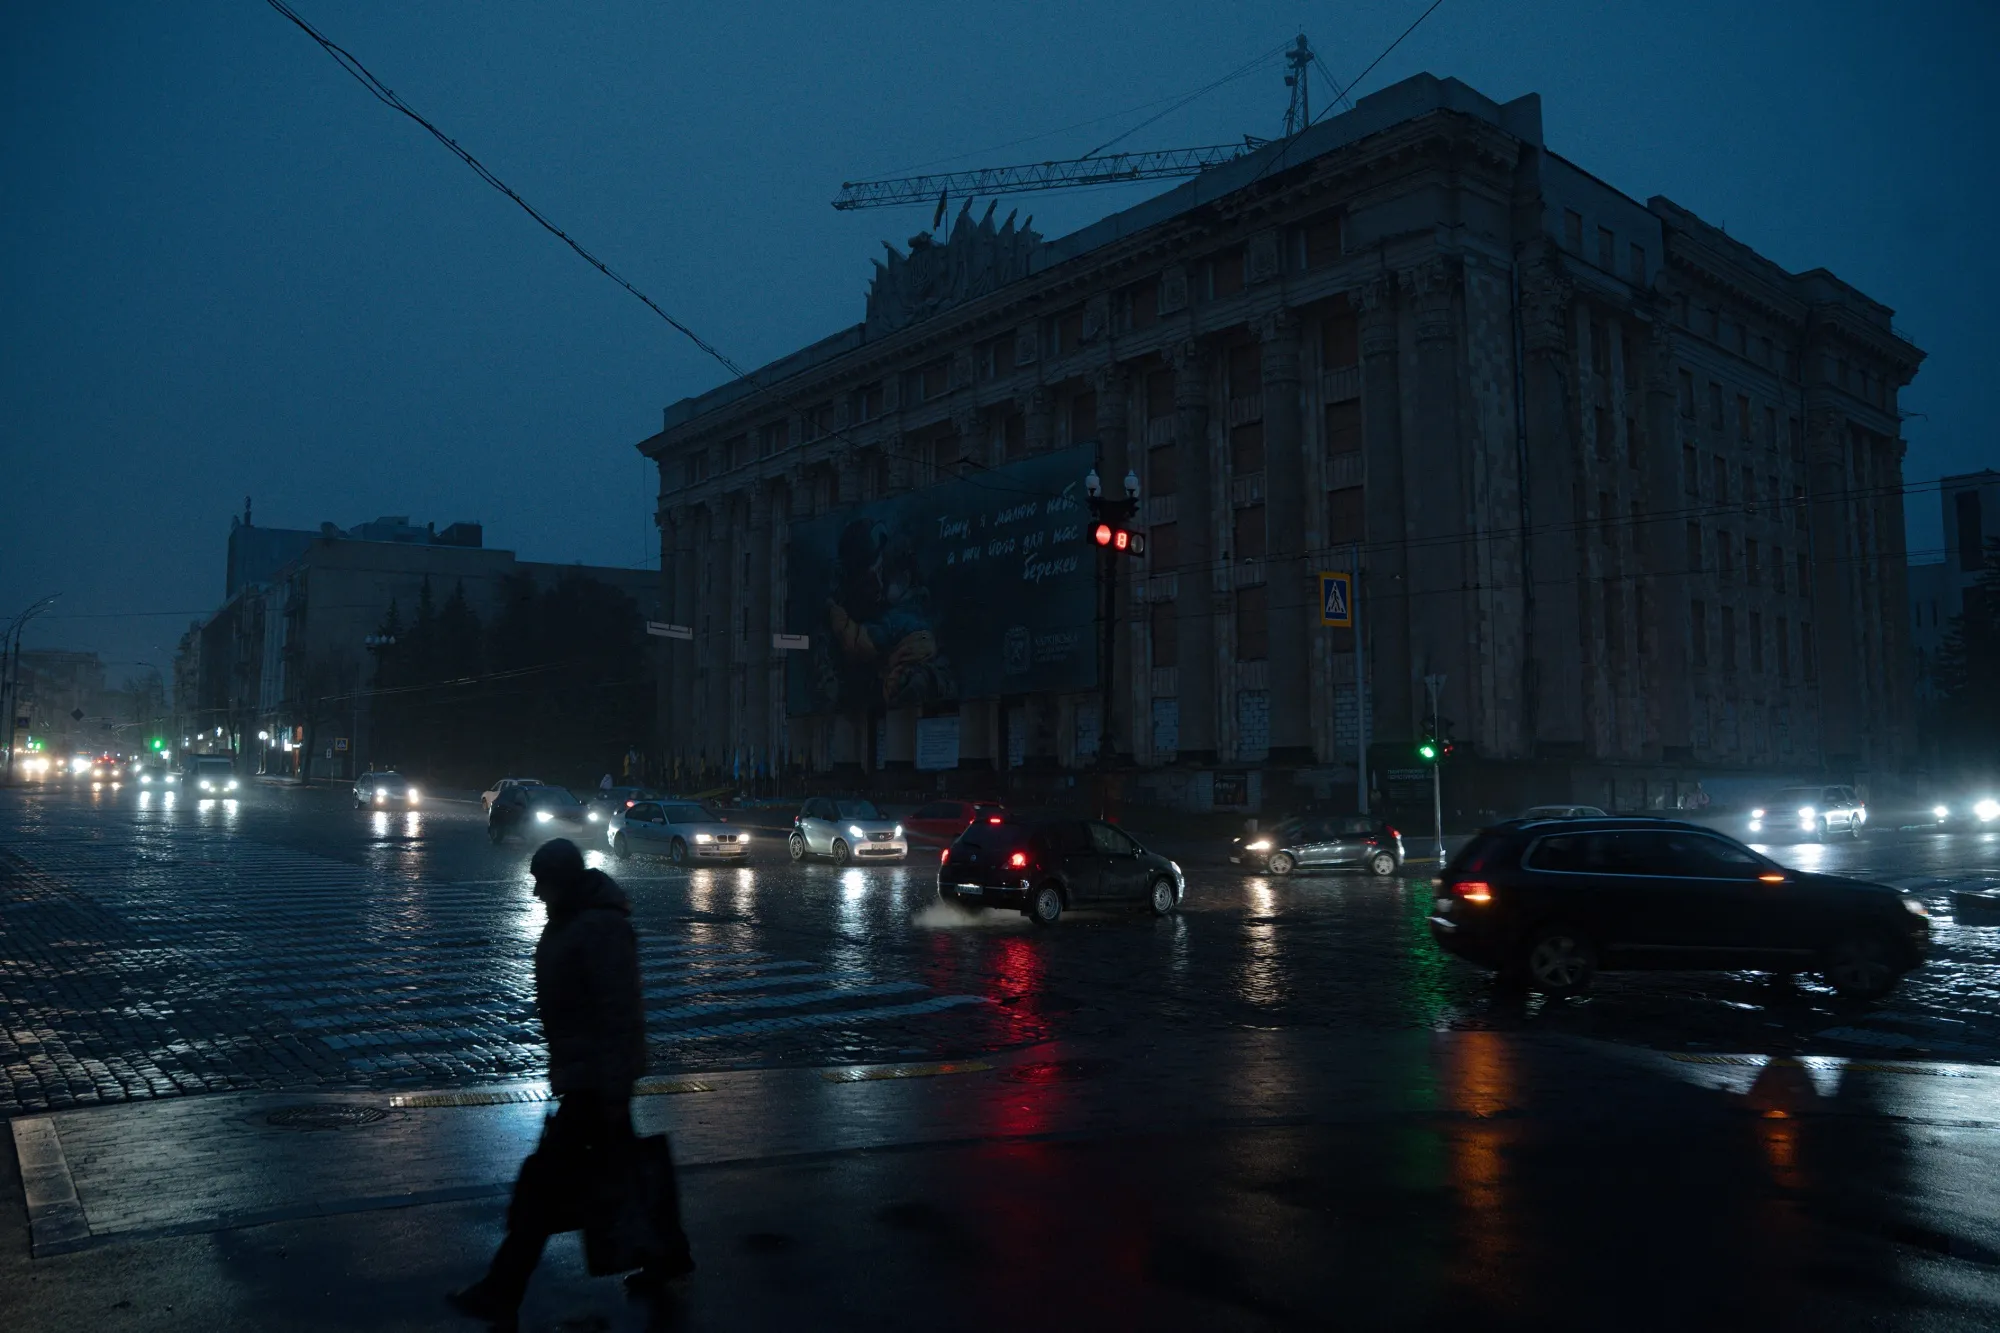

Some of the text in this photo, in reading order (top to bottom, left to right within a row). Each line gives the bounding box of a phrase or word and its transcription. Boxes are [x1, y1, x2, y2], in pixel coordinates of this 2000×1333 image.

[979, 513, 987, 528] я
[994, 501, 1038, 527] малюю
[947, 551, 955, 565] а
[988, 537, 1015, 557] його
[1022, 530, 1044, 555] для
[1052, 525, 1079, 545] нас
